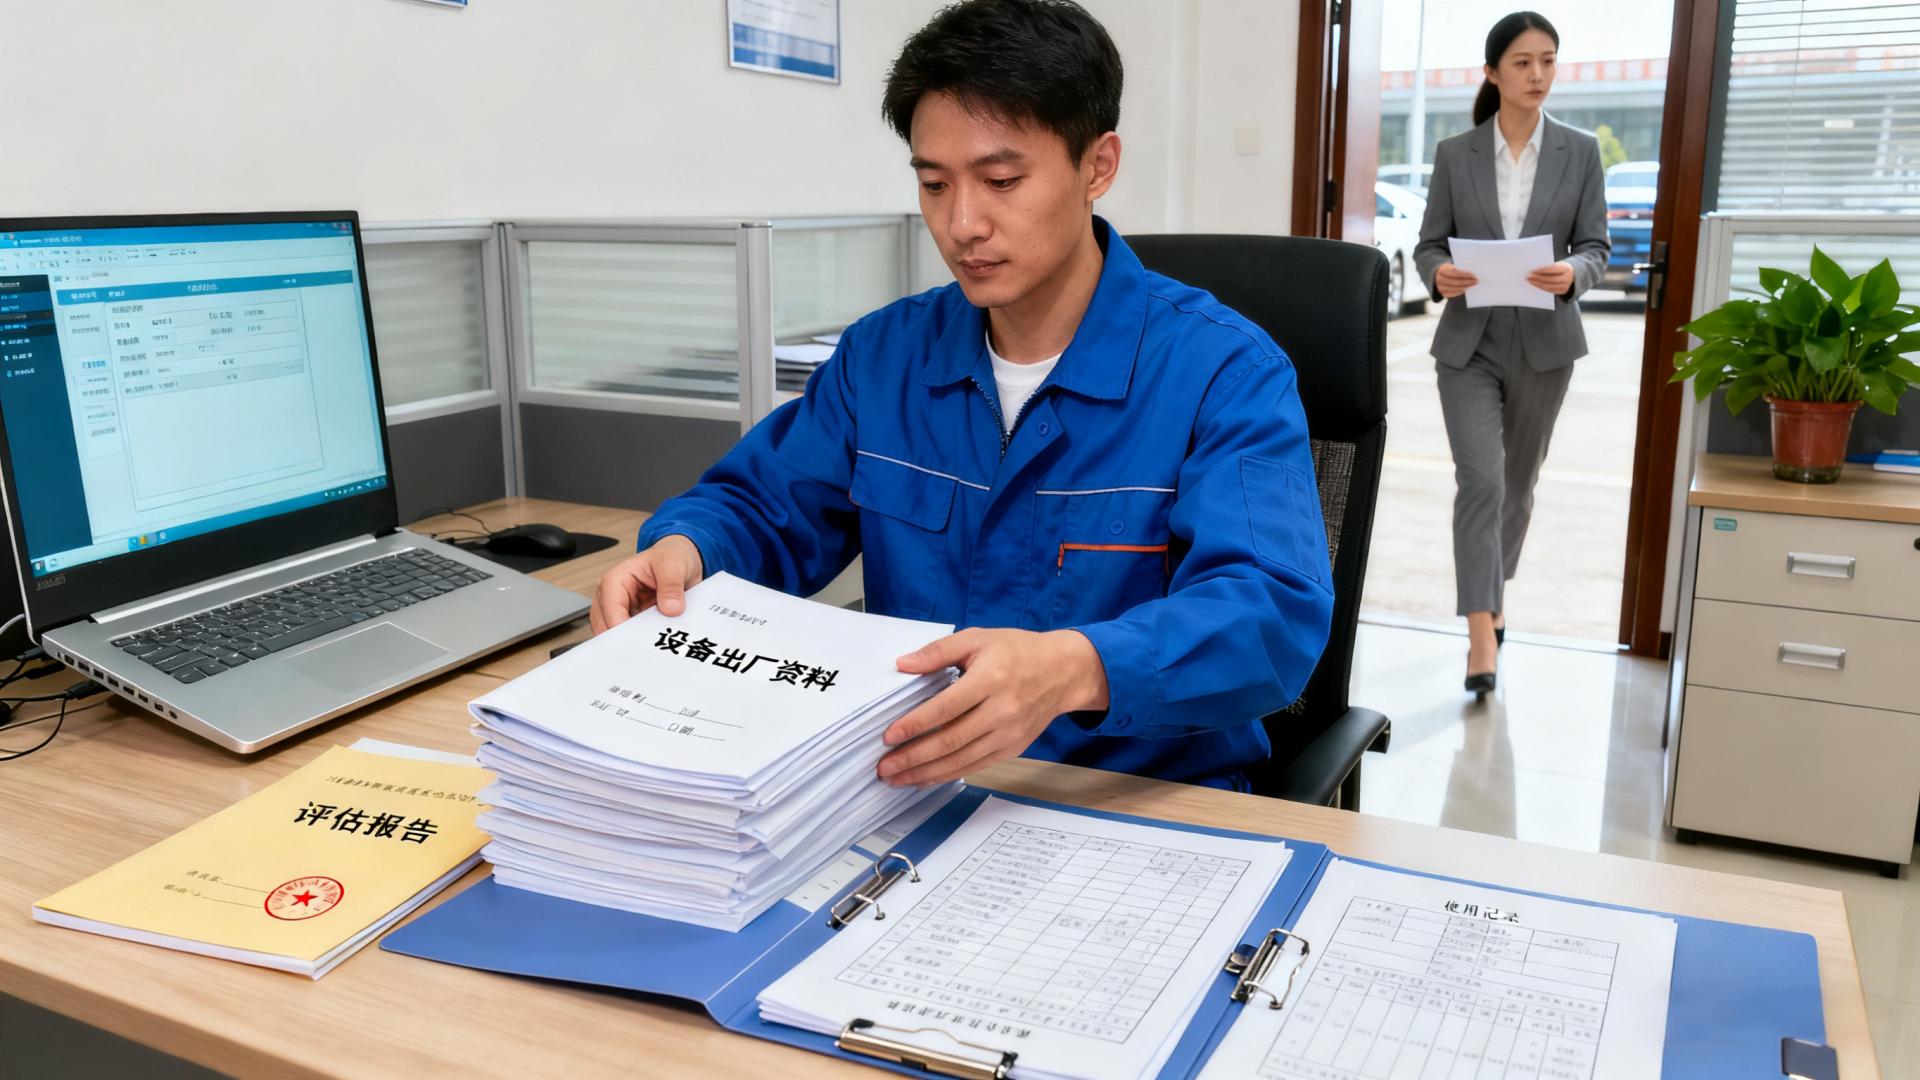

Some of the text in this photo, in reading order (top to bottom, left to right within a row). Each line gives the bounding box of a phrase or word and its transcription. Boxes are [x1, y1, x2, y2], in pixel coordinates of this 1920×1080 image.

[654, 627, 840, 692] 设备出厂资料
[294, 801, 438, 844] 评估报告
